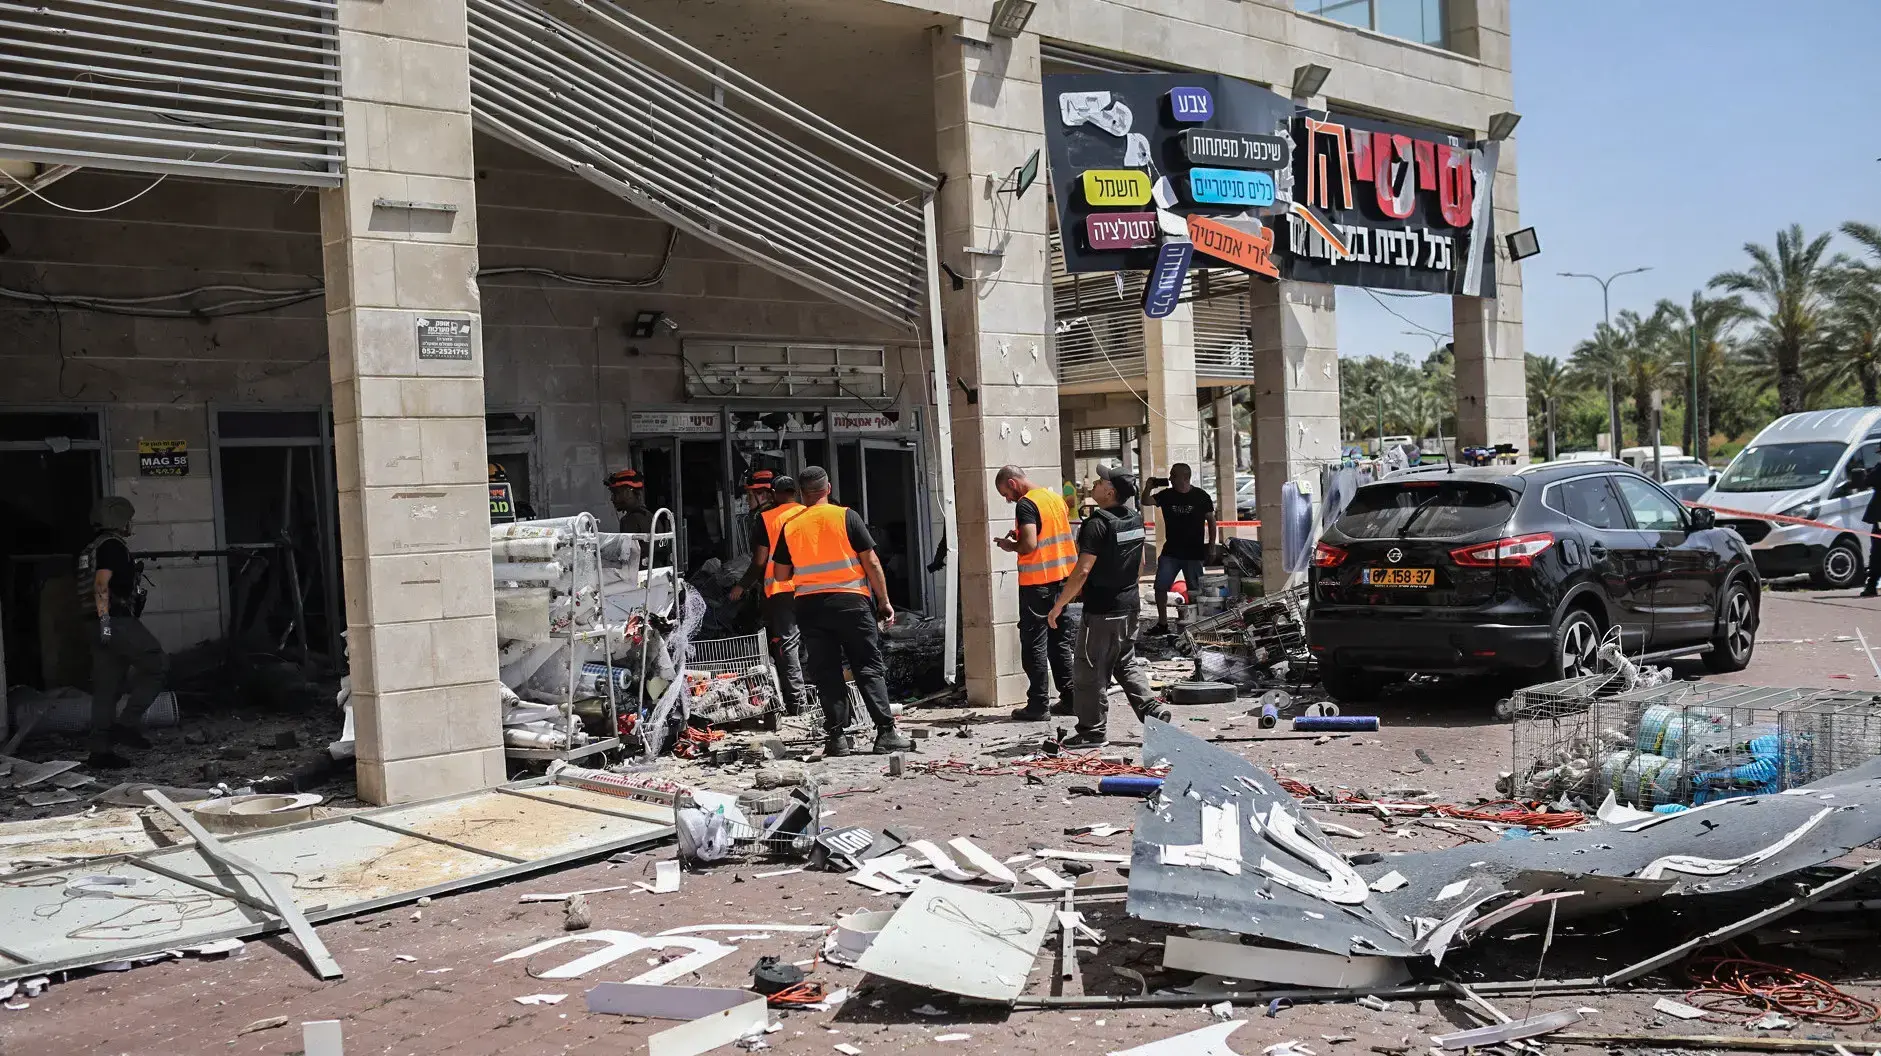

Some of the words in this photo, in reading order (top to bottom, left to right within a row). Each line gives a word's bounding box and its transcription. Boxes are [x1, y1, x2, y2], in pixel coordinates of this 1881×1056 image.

[1178, 95, 1208, 114] צבע
[1192, 136, 1239, 158] מפתחות
[1241, 137, 1281, 162] שיכפול
[1094, 176, 1140, 198] חשמל
[1194, 178, 1245, 198] סניטריים
[1350, 128, 1473, 228] סיטי
[1248, 180, 1273, 201] כלים
[1190, 223, 1243, 257] אמבטיה
[1375, 225, 1419, 267] לבית
[1158, 247, 1186, 290] עבודה
[1151, 293, 1174, 315] כלי
[141, 457, 170, 465] MAG
[174, 456, 187, 465] 58
[490, 501, 509, 513] מב
